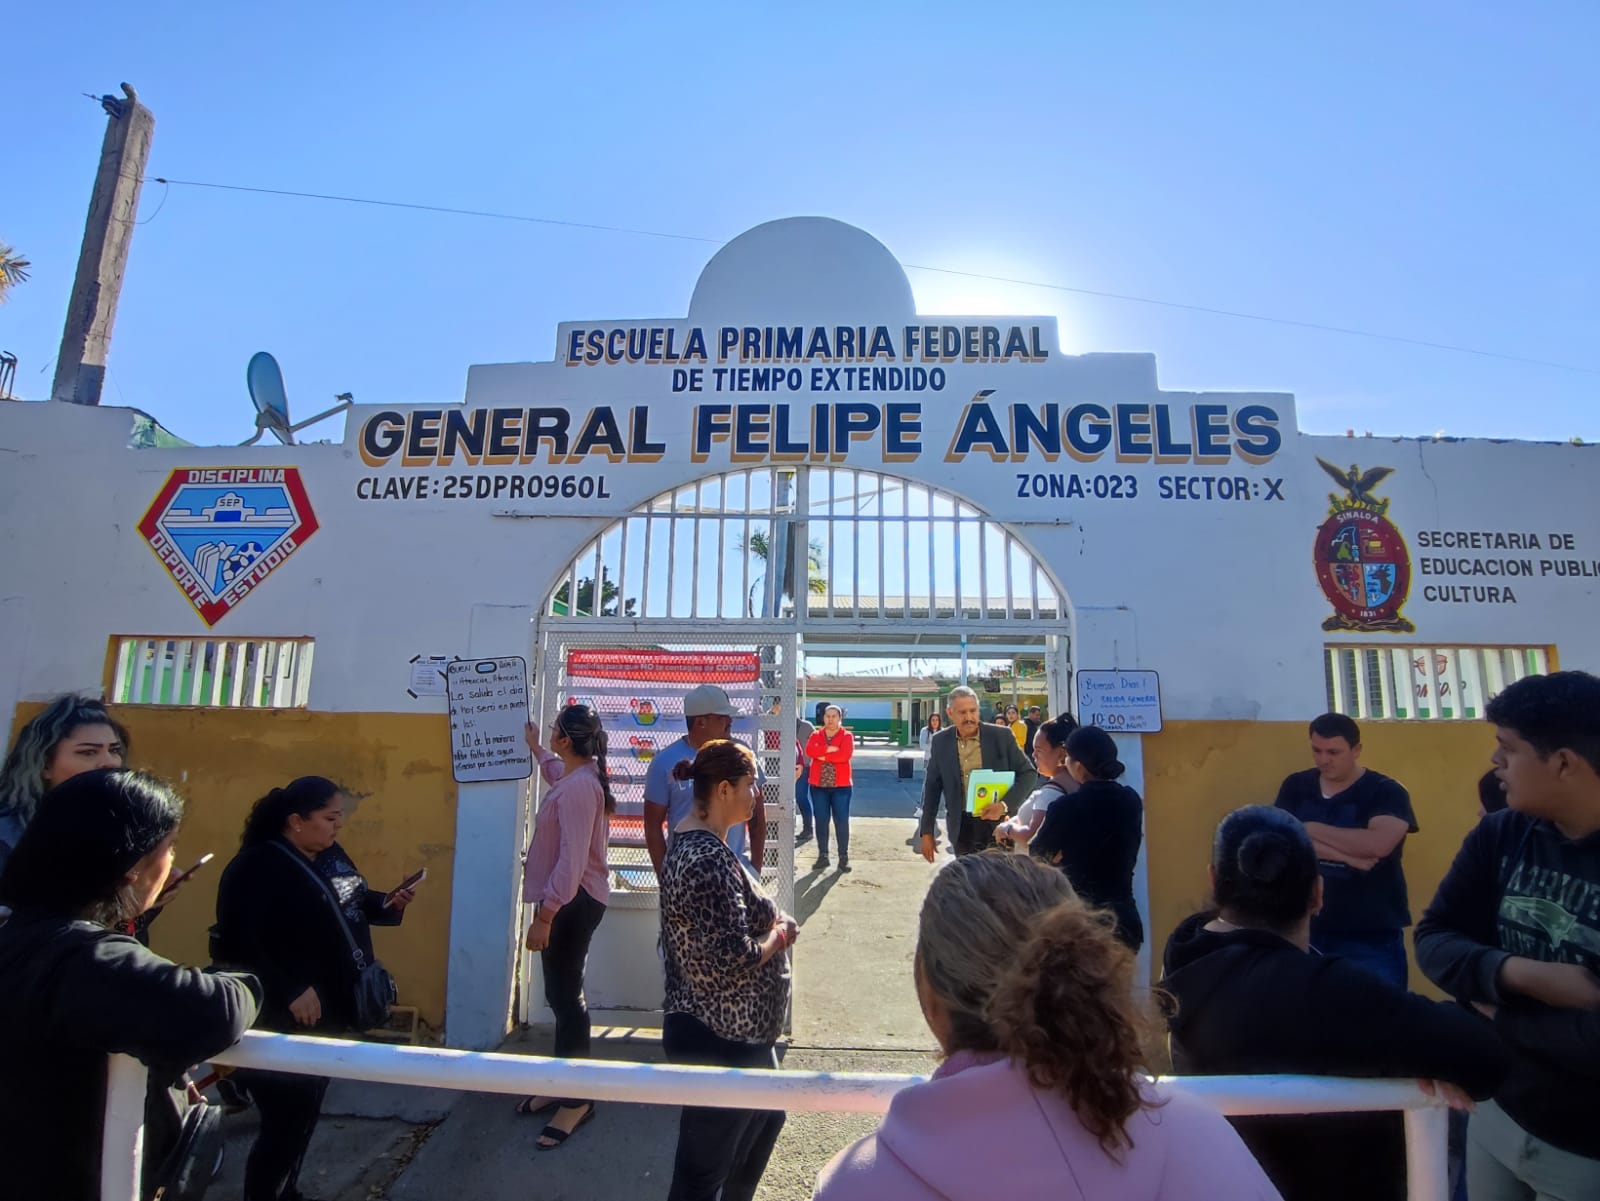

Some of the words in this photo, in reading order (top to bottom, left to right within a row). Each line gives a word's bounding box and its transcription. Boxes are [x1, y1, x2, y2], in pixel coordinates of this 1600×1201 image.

[566, 327, 707, 366] ESCUELA
[717, 325, 896, 363] PRIMARIA
[903, 325, 1049, 363] FEDERAL
[672, 368, 703, 392] DE
[712, 368, 803, 391] TIEMPO
[810, 366, 946, 391] EXTENDIDO
[358, 404, 667, 467] GENERAL
[690, 402, 922, 463] FELIPE
[944, 389, 1283, 465] ÁNGELES
[188, 469, 286, 483] DISCIPLINA
[219, 498, 240, 507] SEP
[1336, 511, 1379, 524] SINALOA
[1417, 531, 1542, 550] SECRETARIA
[1548, 533, 1575, 550] DE
[149, 531, 209, 609] DEPORTE
[222, 536, 298, 609] ESTUDIO
[1420, 557, 1534, 577] EDUCACION
[1423, 585, 1517, 604] CULTURA
